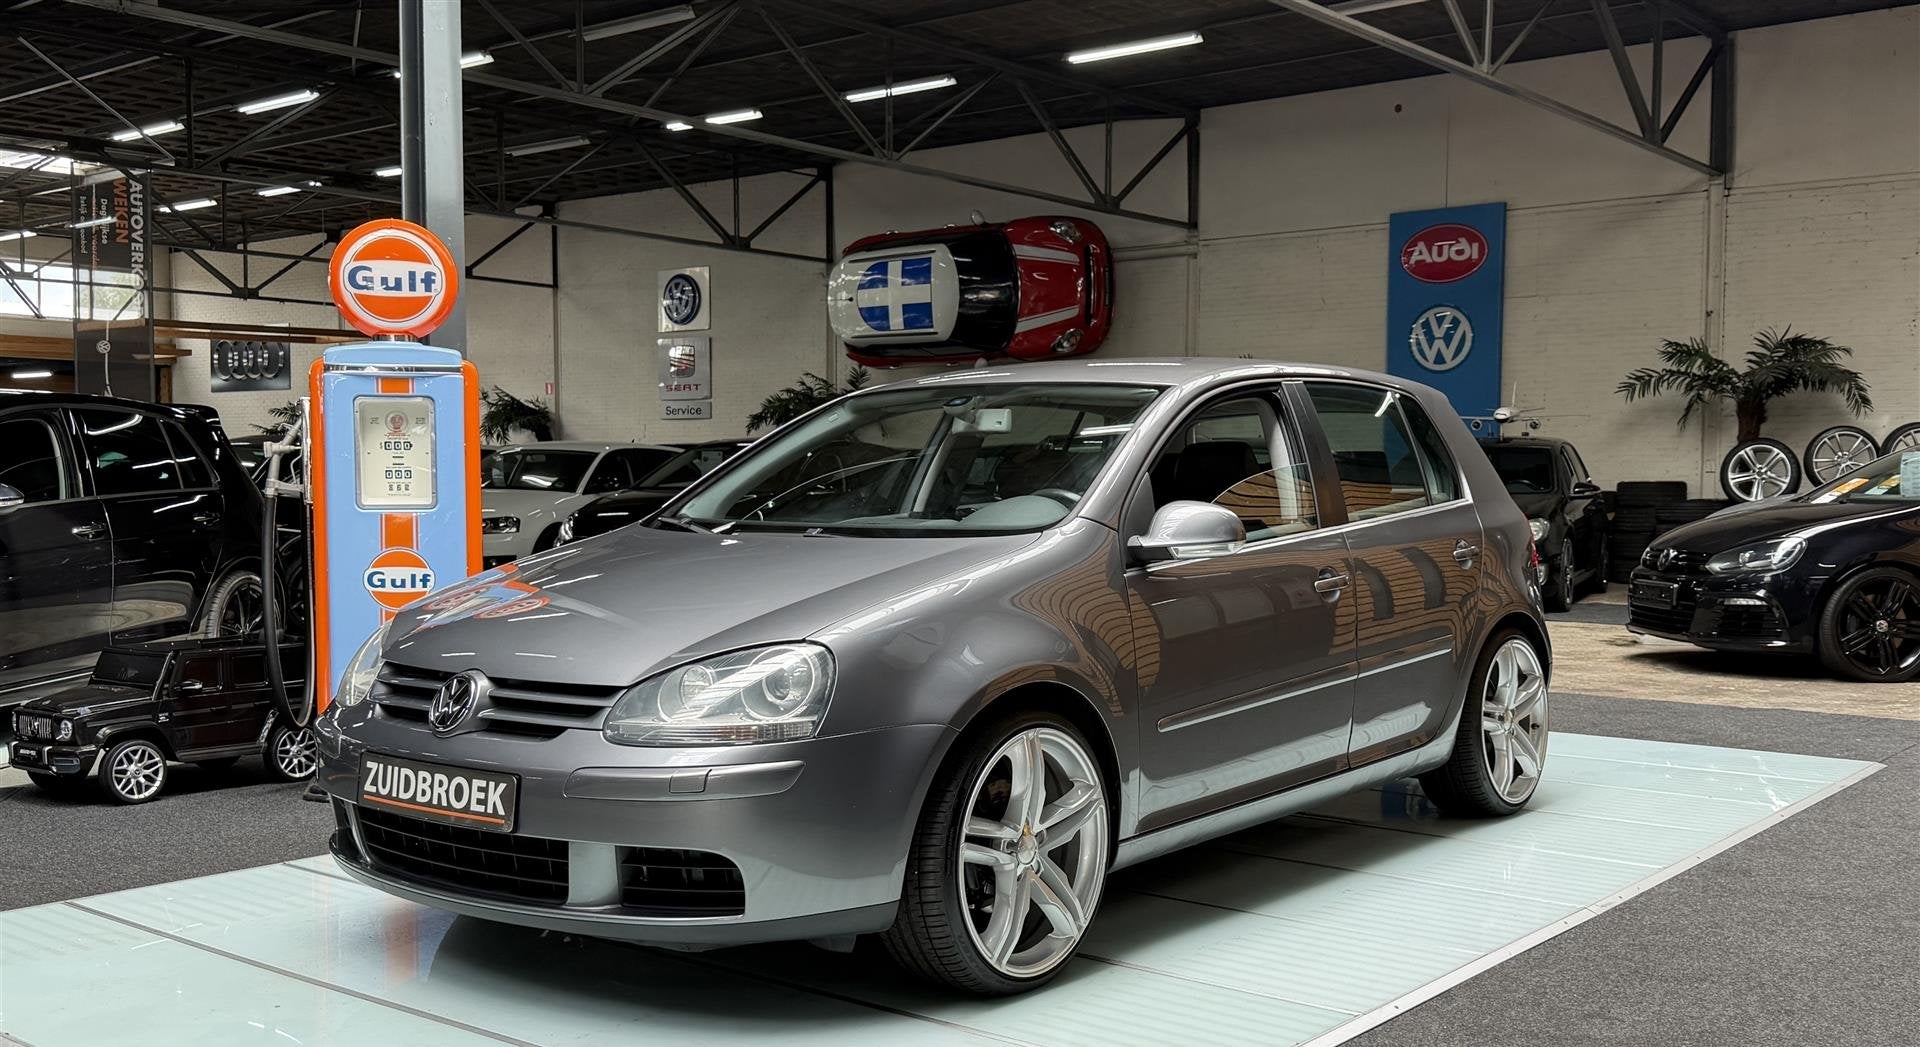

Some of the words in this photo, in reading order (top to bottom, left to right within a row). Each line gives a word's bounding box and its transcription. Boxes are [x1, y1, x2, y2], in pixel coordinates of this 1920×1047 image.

[113, 177, 128, 244] WEKEN
[347, 265, 437, 293] Gulf
[665, 383, 701, 392] SEAT
[665, 405, 702, 416] Service
[366, 570, 431, 589] Gulf
[363, 760, 507, 816] ZUIDBROEK
